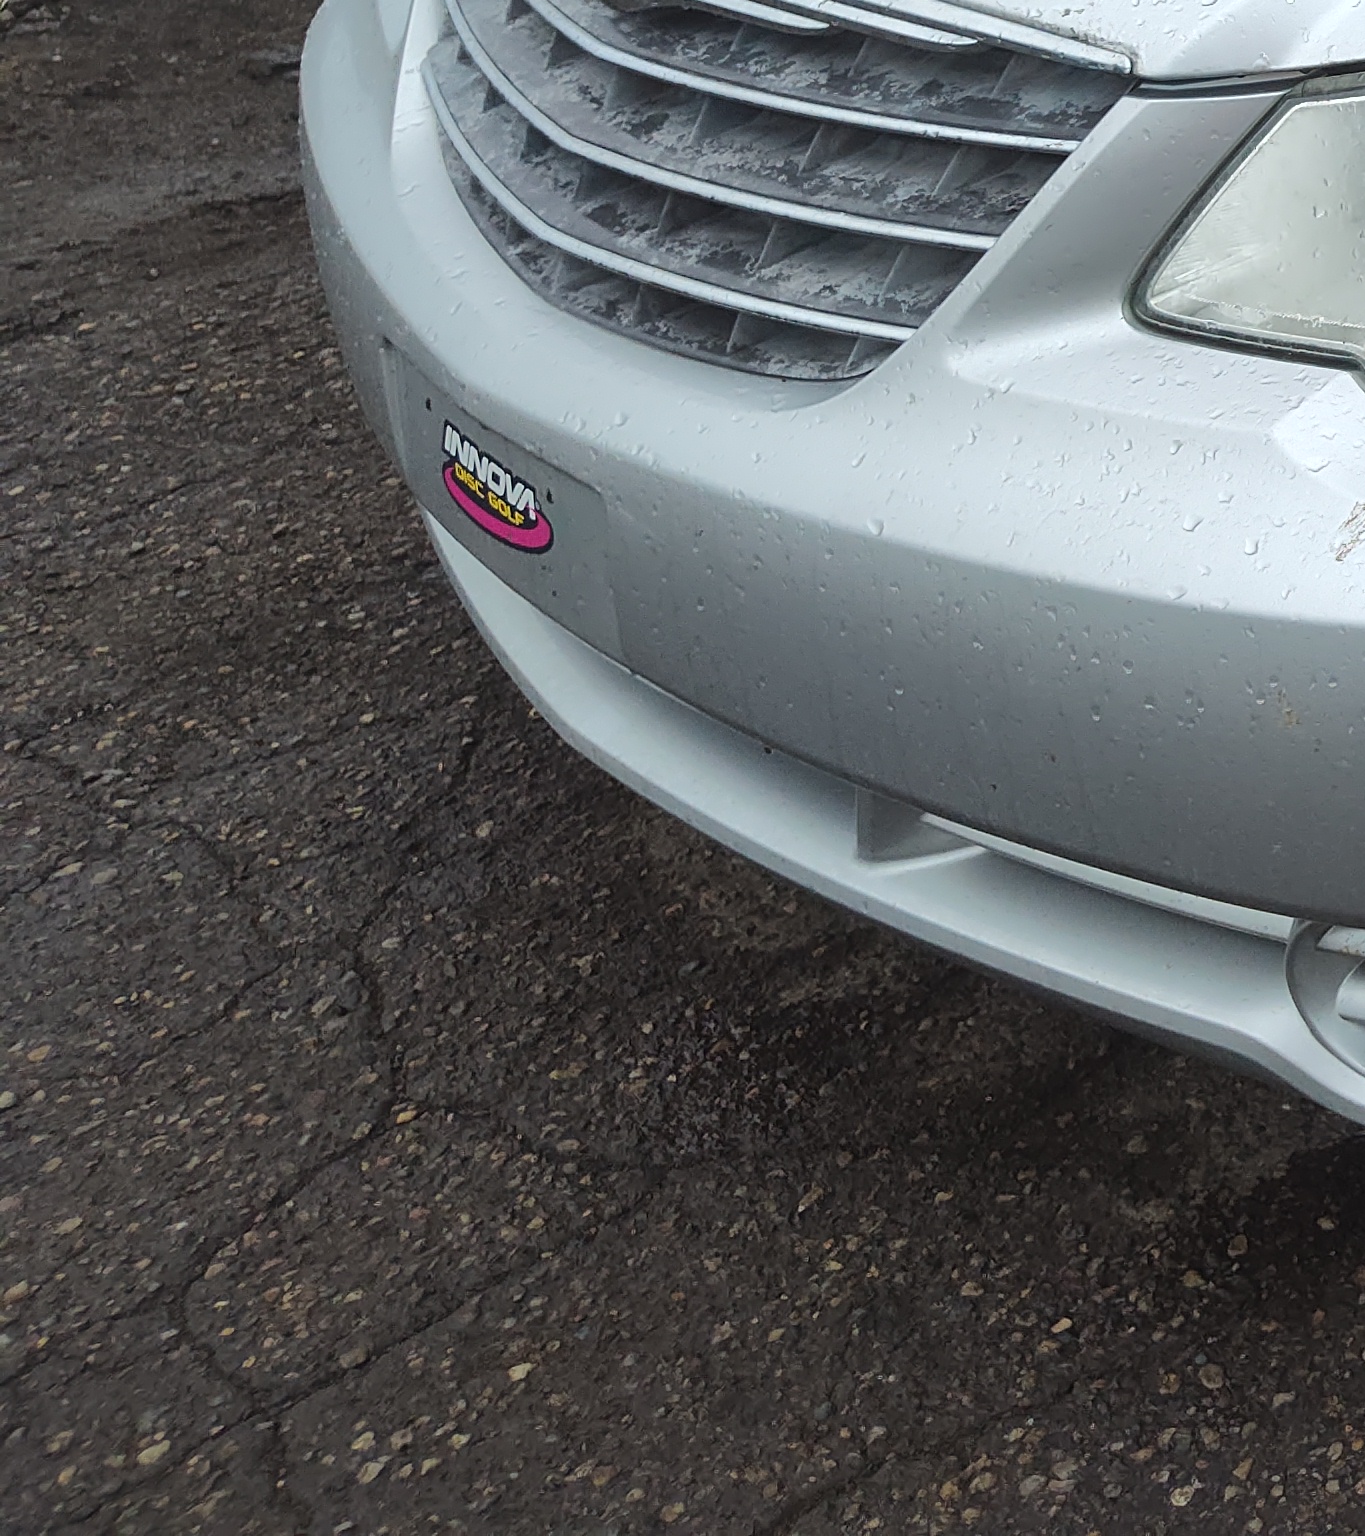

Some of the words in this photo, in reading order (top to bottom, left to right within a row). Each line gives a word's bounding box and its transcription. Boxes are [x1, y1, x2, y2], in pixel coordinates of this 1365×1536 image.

[444, 424, 536, 521] INNOVA
[454, 462, 485, 499] DISC
[488, 490, 525, 526] GOLF
